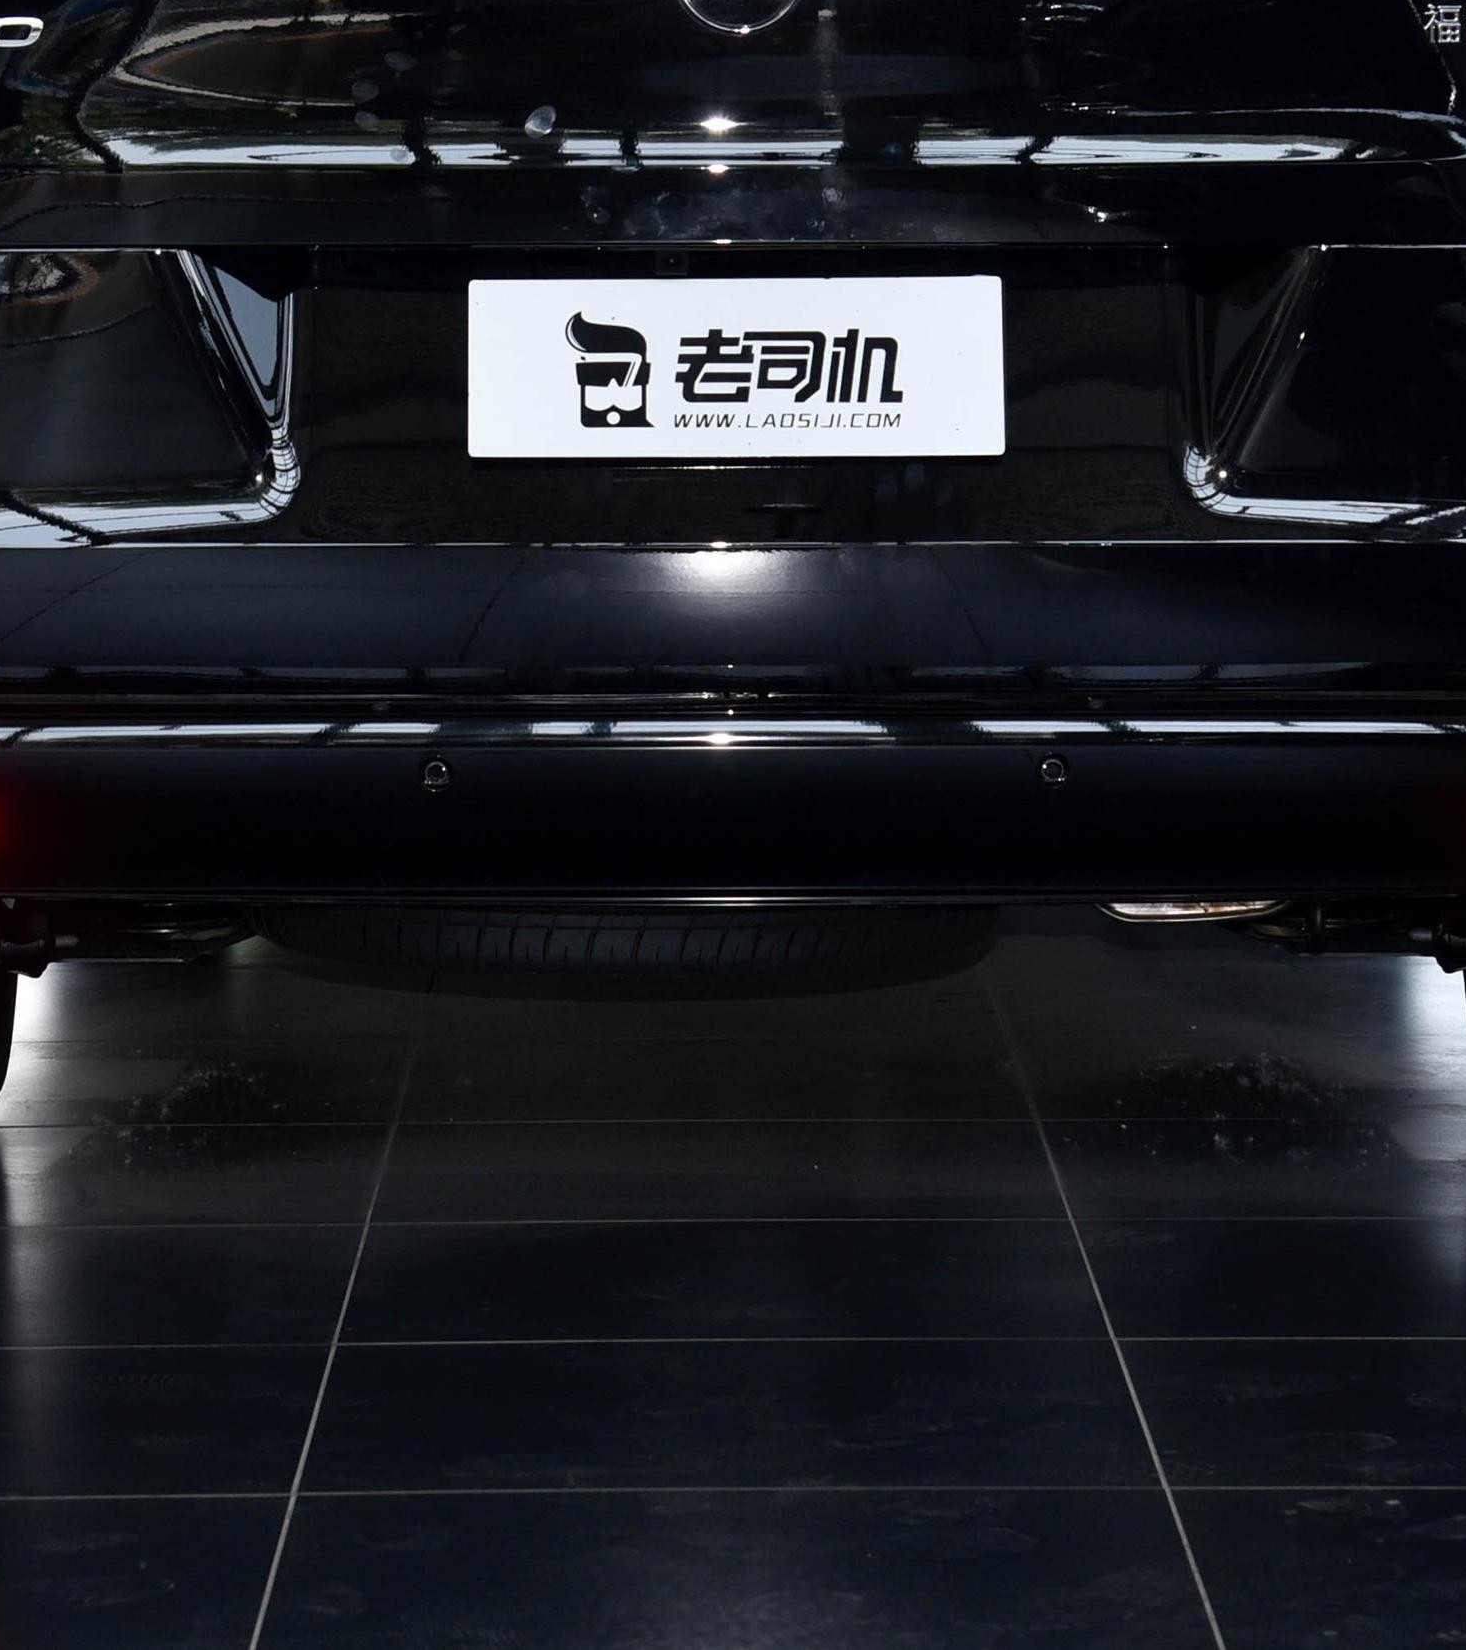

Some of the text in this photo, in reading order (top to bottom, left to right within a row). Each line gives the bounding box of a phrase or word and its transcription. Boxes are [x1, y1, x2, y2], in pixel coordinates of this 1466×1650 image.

[675, 329, 903, 403] 老司机
[674, 413, 902, 428] WWW.LAOSIJI.COM
